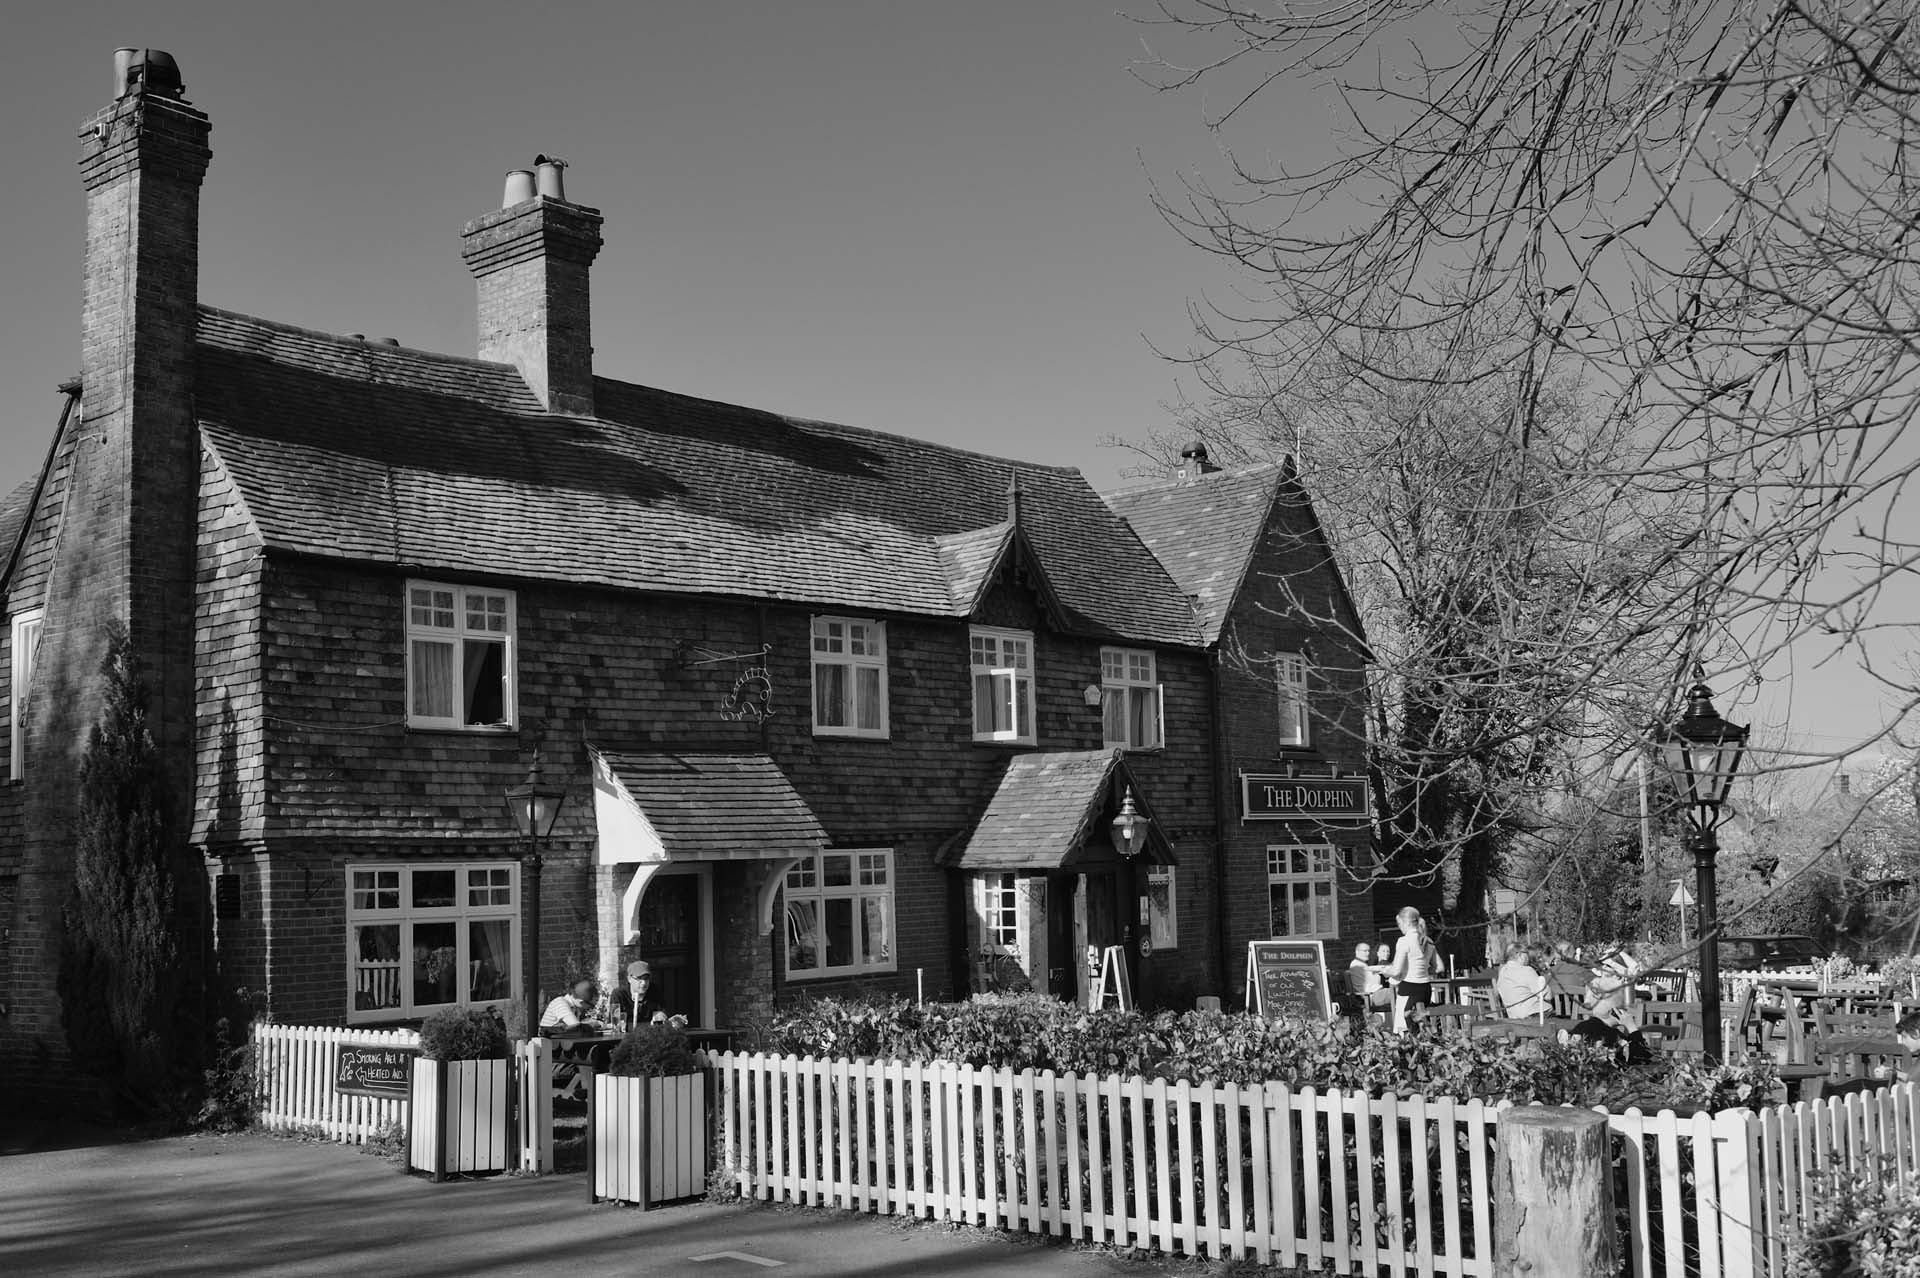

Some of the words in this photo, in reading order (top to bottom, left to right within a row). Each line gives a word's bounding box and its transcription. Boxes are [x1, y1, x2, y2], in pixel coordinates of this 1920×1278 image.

[1263, 785, 1293, 808] THE
[1295, 786, 1354, 808] DOLPHIN
[1262, 952, 1278, 960] THE
[1280, 952, 1313, 960] DOLPHIN
[356, 1049, 382, 1064] SMOKING
[384, 1051, 396, 1064] AREA
[367, 1066, 390, 1079] HEATED
[392, 1068, 403, 1079] AND
